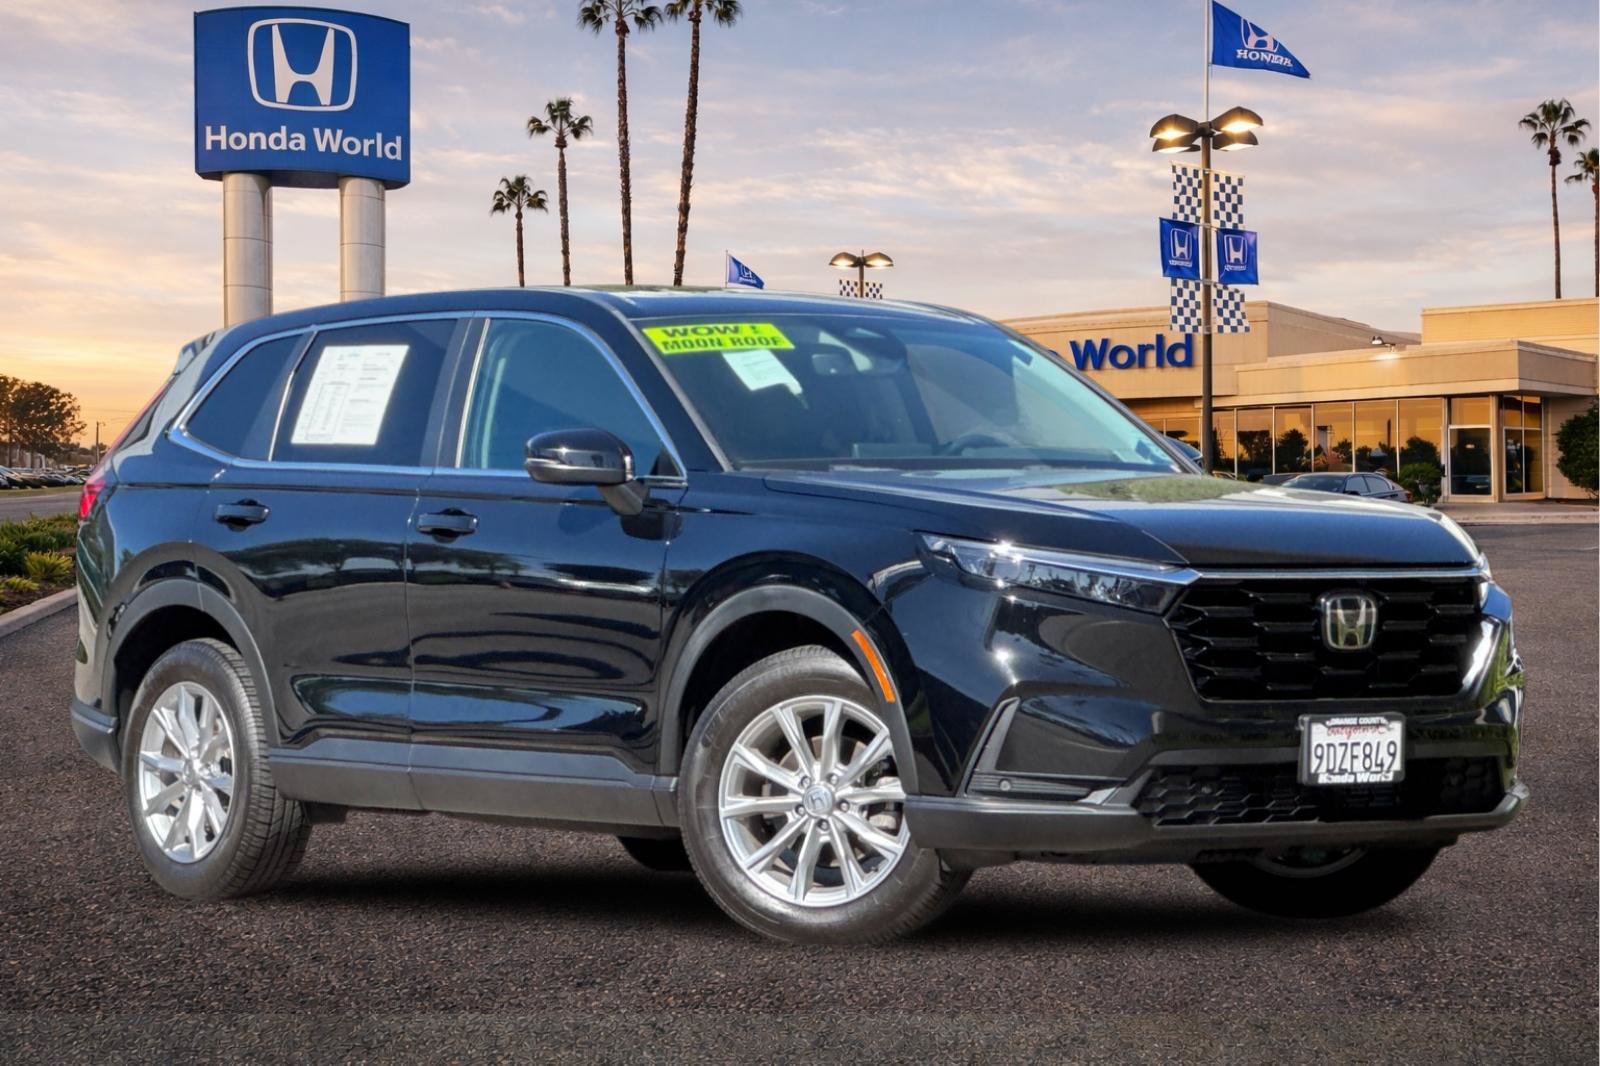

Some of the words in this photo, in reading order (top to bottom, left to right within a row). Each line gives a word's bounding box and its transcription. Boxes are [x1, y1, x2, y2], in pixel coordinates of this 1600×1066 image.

[205, 125, 306, 151] Honda
[312, 127, 402, 161] World
[661, 336, 724, 350] MOON
[729, 336, 783, 347] ROOF
[662, 325, 740, 338] WOW
[1069, 333, 1195, 371] World
[1313, 740, 1398, 775] 9DZF849
